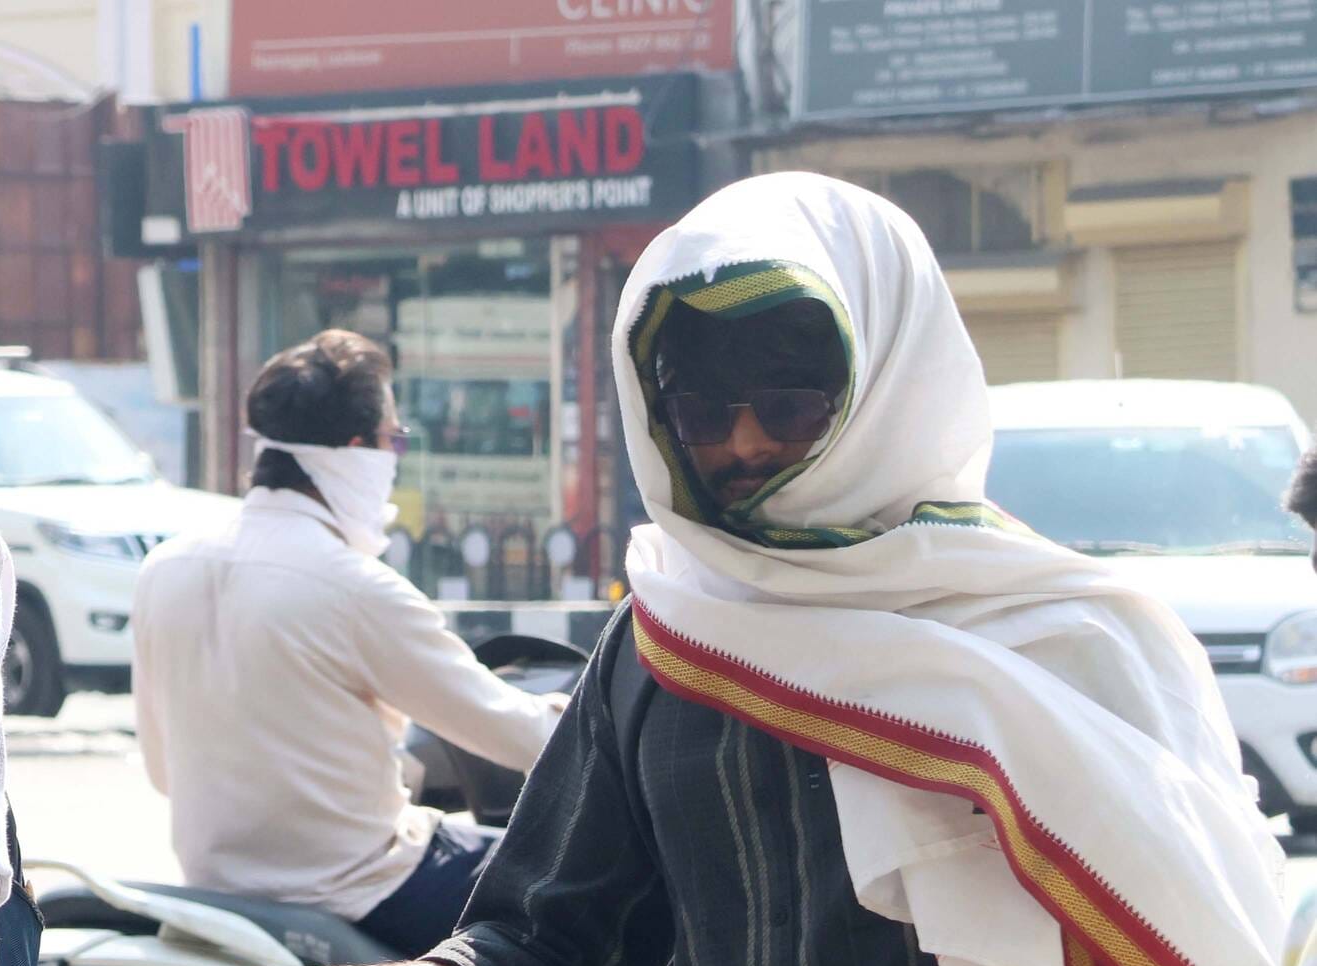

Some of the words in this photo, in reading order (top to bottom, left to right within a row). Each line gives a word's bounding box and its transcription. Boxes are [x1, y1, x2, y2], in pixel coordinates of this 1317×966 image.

[253, 116, 460, 192] TOWEL
[478, 104, 646, 181] LAND
[395, 189, 412, 219] A
[413, 186, 460, 219] UNIT
[461, 184, 488, 217] OF
[592, 175, 653, 208] POINT
